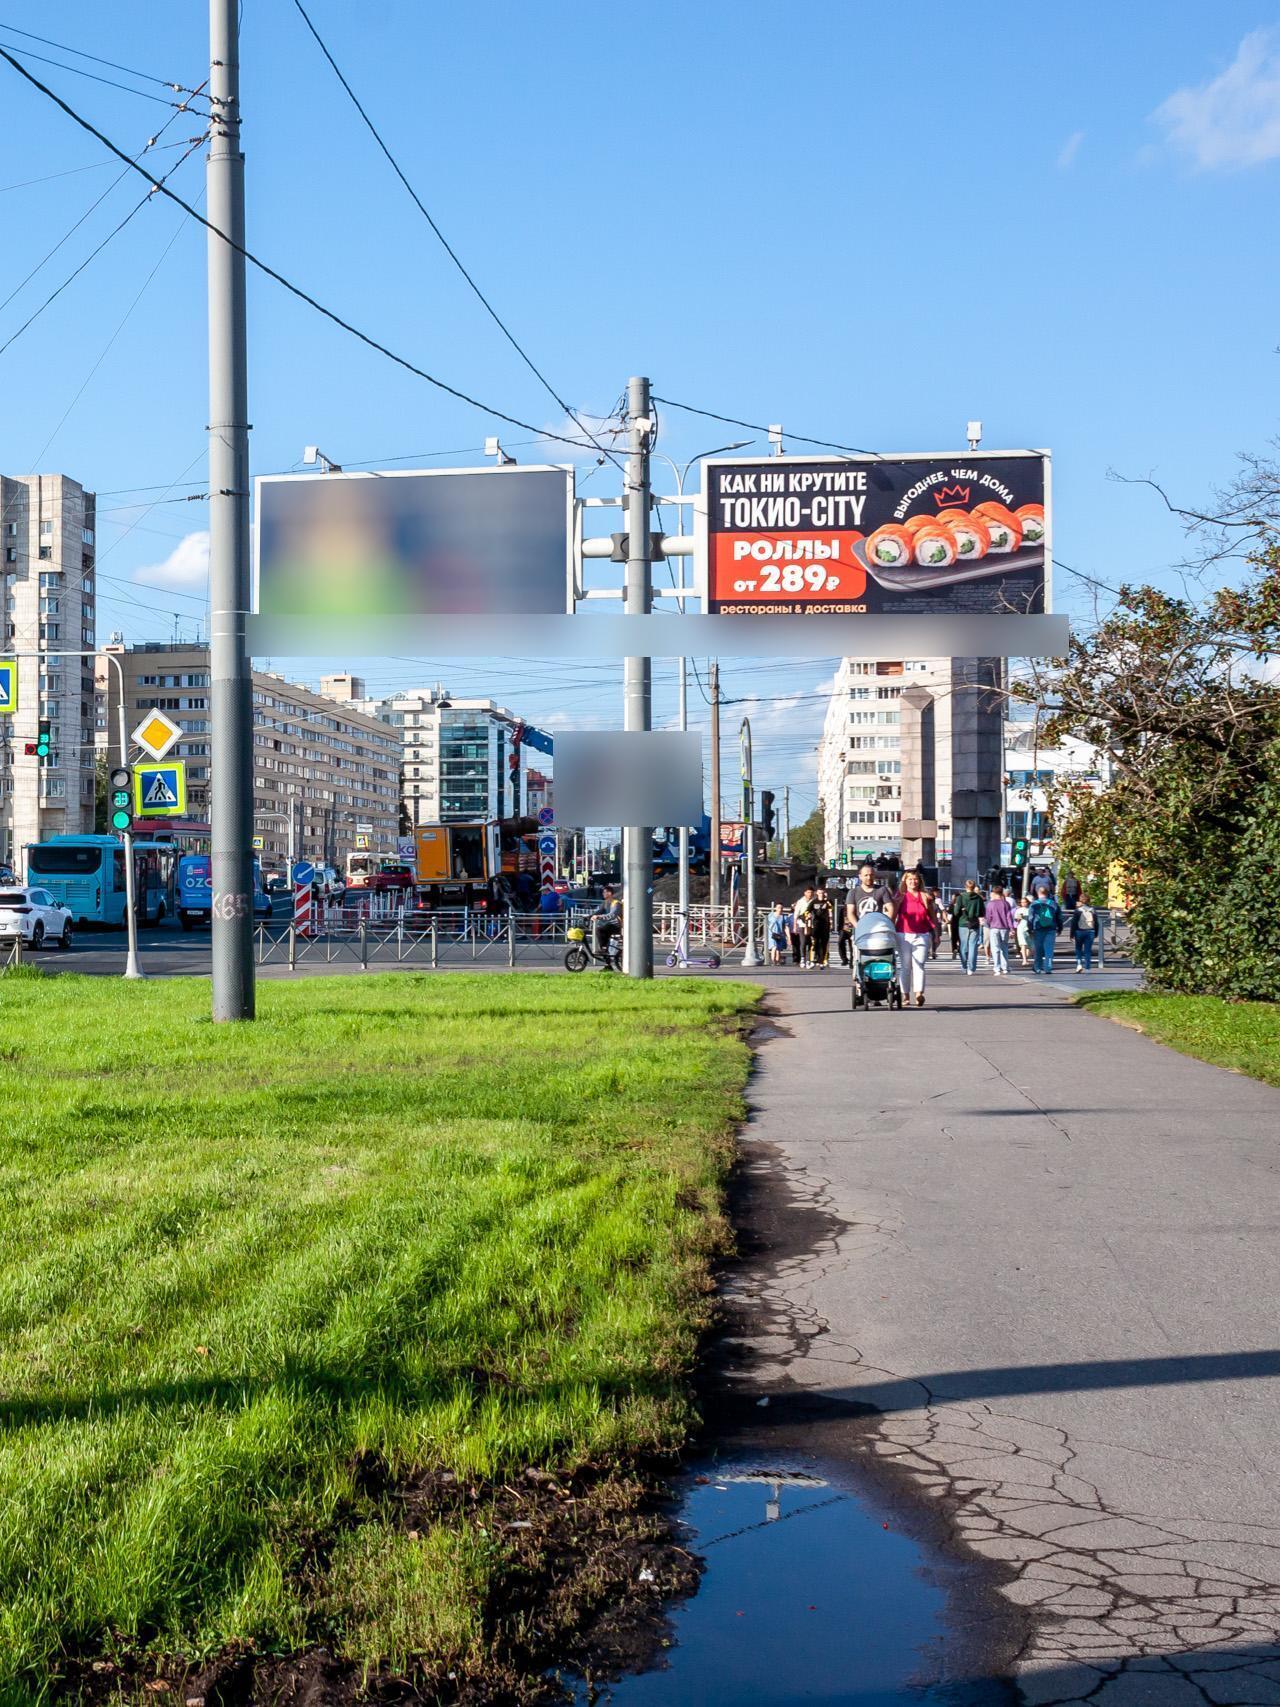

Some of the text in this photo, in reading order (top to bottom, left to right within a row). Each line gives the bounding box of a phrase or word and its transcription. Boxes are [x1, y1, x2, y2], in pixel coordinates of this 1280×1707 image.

[720, 472, 867, 493] КАК НИ КРУТИТЕ
[893, 469, 1014, 519] ВЫГОДНЕЕ, ЧЕМ ДОМА
[720, 495, 867, 528] ТОКИО-CITY
[733, 539, 840, 561] РОЛЛЫ
[733, 580, 757, 592] от
[720, 604, 867, 614] рестораны & доставка
